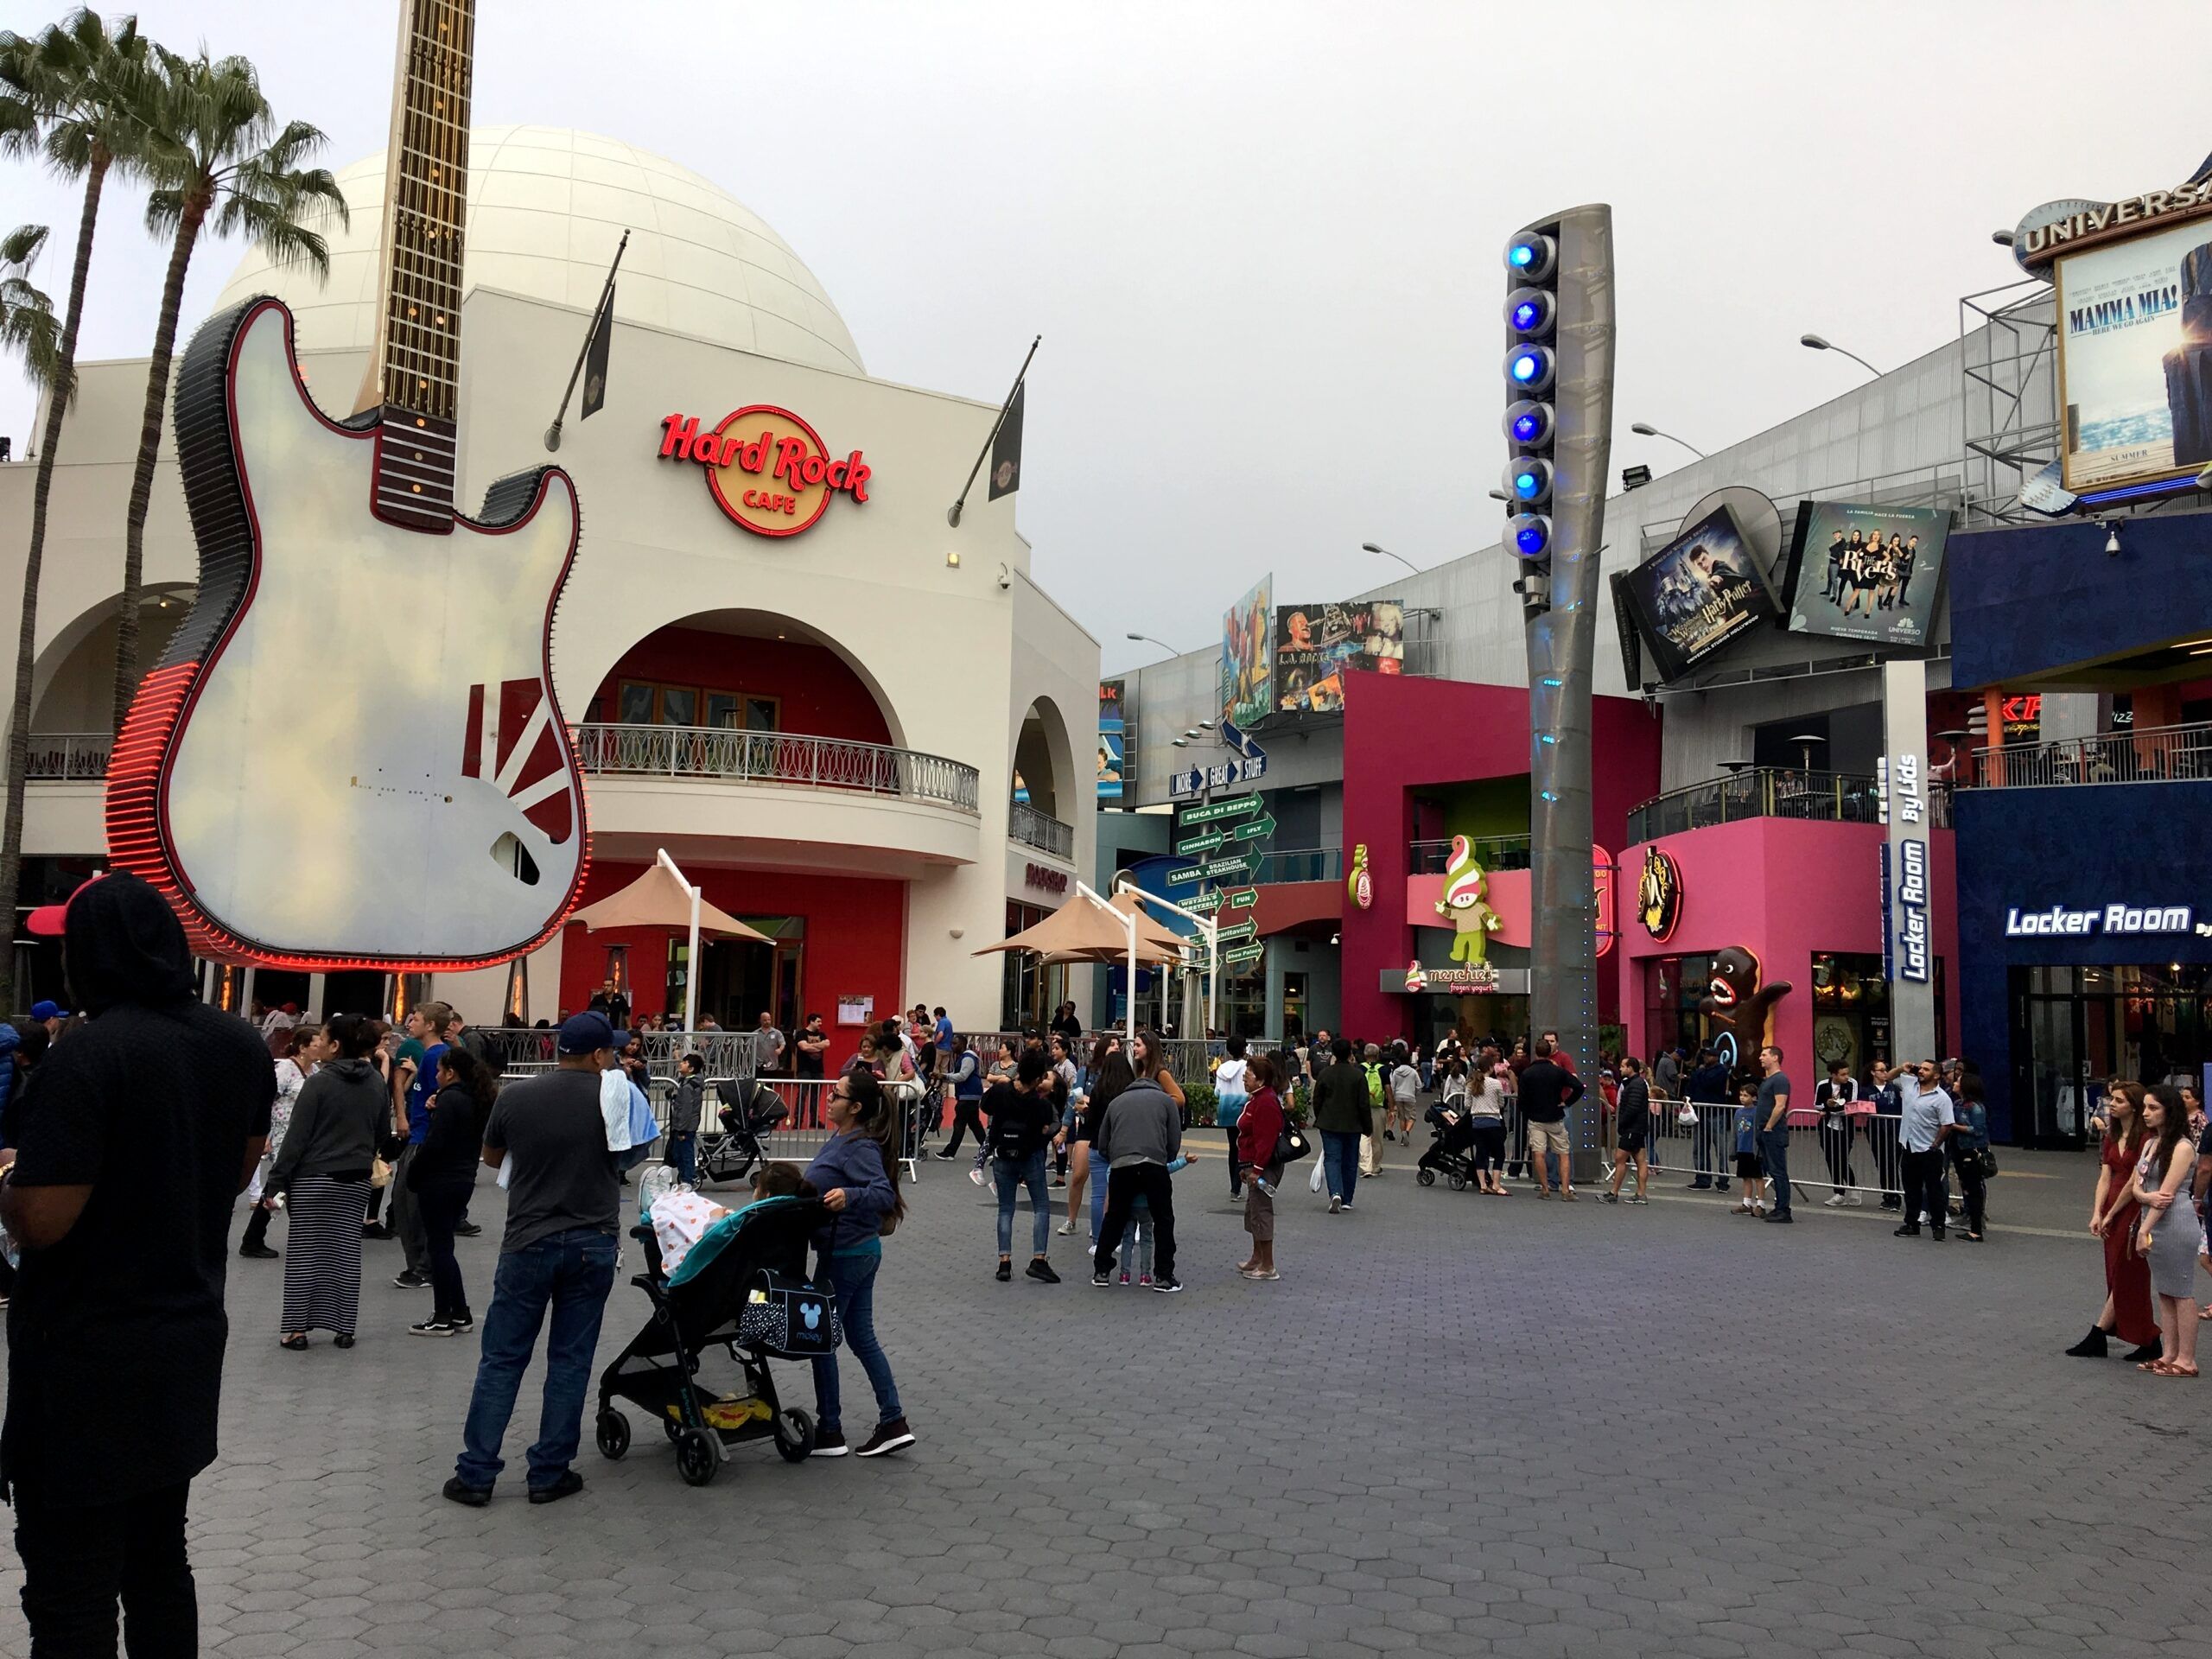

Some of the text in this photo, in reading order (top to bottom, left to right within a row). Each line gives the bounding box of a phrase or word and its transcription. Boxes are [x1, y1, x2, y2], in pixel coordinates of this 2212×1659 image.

[2069, 296, 2135, 334] MAMMA
[2138, 284, 2177, 317] MIA!
[2092, 315, 2155, 335] HERE WE GO AGAIN
[658, 413, 872, 504] Hard Rock
[2110, 449, 2148, 461] SUMMER
[743, 489, 796, 514] CAFE
[1840, 550, 1897, 582] Riveras
[1864, 556, 1876, 566] THE
[1701, 580, 1752, 624] Harry Potter
[1687, 646, 1712, 664] UNIVERSAL
[1711, 633, 1731, 649] STUDIOS
[1730, 614, 1759, 636] HOLLYWOOD
[1888, 626, 1921, 635] UNIVERSO
[1175, 757, 1262, 793] MORE GREAT STUFF
[1186, 810, 1211, 820] BUCA
[1227, 800, 1257, 811] BEPPO
[1247, 825, 1262, 834] IFLY
[1181, 836, 1221, 851] CINNABON
[1206, 862, 1248, 876] STEAKHOUSE
[1208, 858, 1242, 870] BRAZILIAN
[1897, 754, 1928, 982] Locker Room By Lids
[1171, 869, 1202, 881] SAMBA
[1180, 894, 1217, 906] WETZEL'S
[2006, 904, 2212, 938] Locker Room By
[1429, 961, 1493, 982] menchie's
[1450, 982, 1492, 993] frozen yogurt
